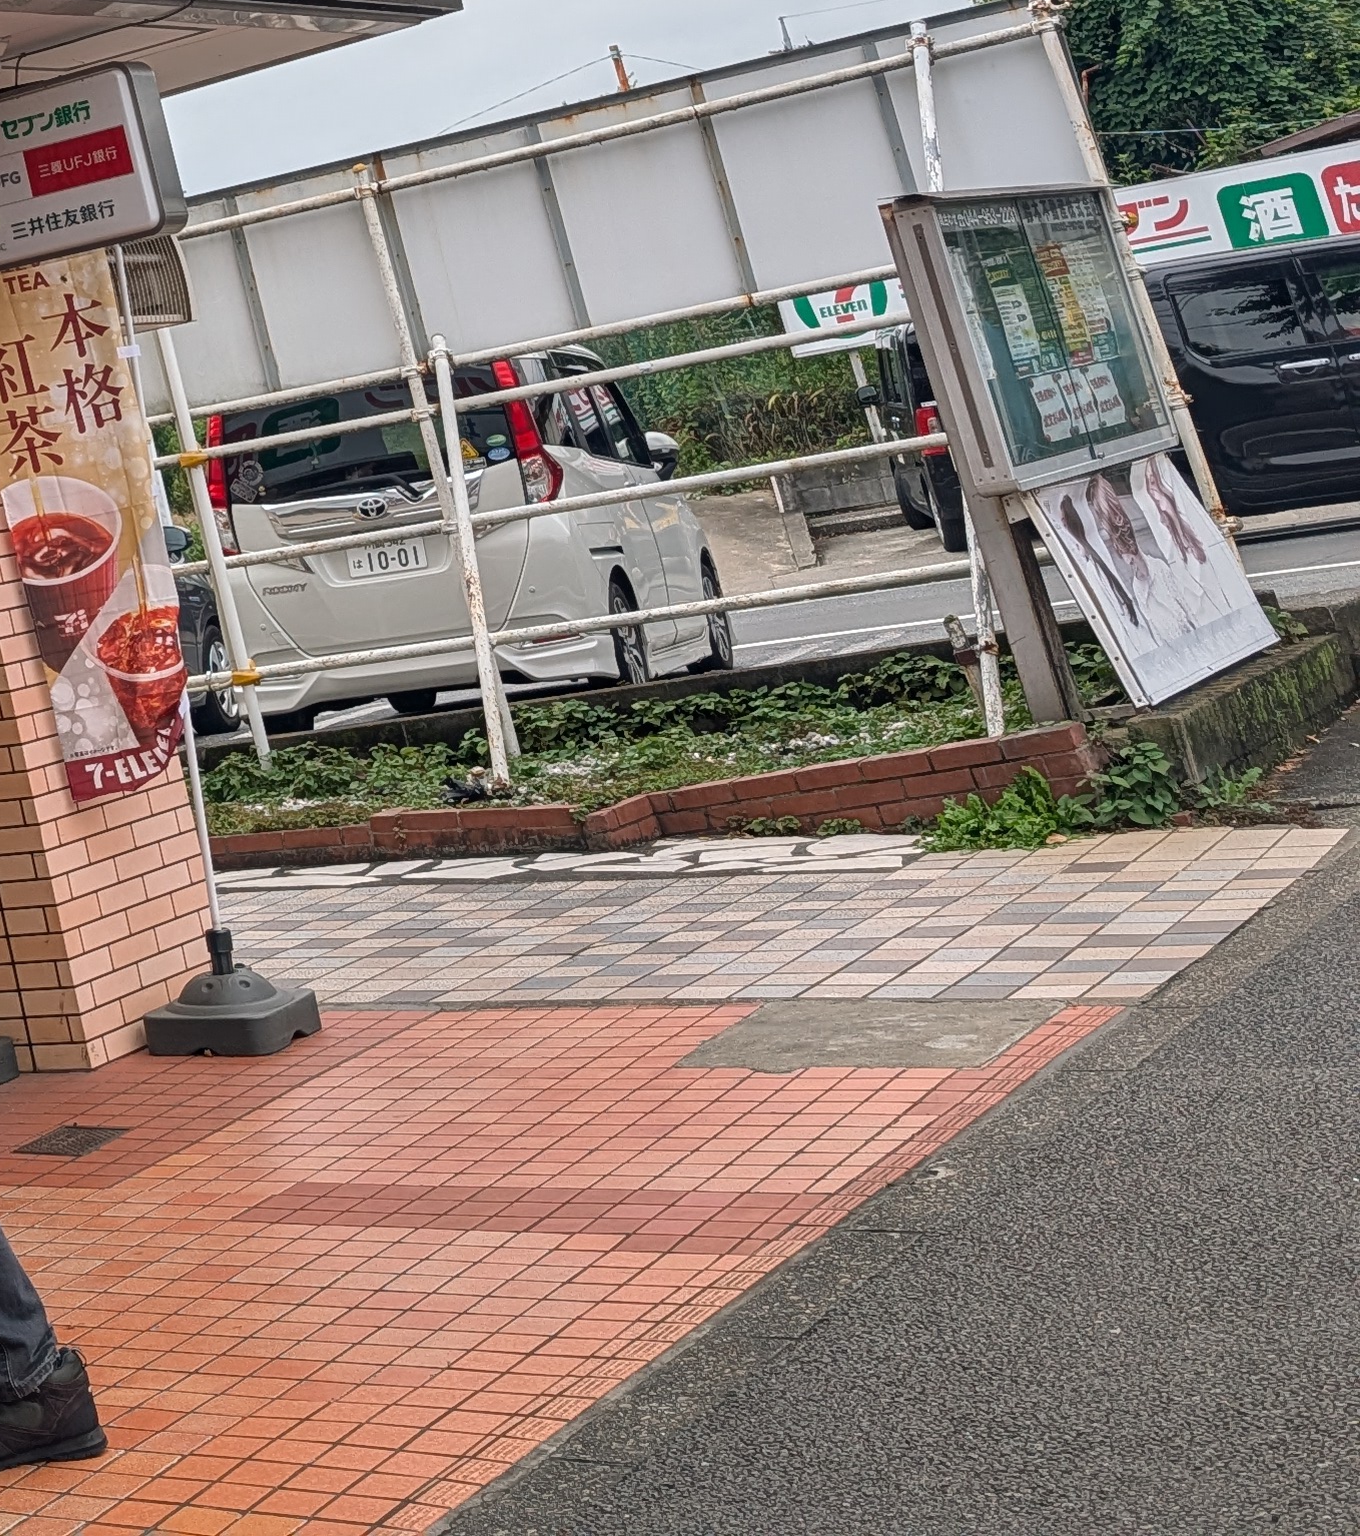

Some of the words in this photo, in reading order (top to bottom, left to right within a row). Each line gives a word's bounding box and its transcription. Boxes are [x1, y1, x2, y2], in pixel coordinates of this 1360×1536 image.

[0, 99, 91, 141] セブン銀行
[38, 146, 118, 179] 三菱UFJ銀行
[10, 199, 116, 242] 三井住友銀行
[1238, 186, 1305, 243] 酒
[3, 271, 50, 295] TEA
[41, 293, 125, 436] 本格
[367, 546, 419, 572] 10-01
